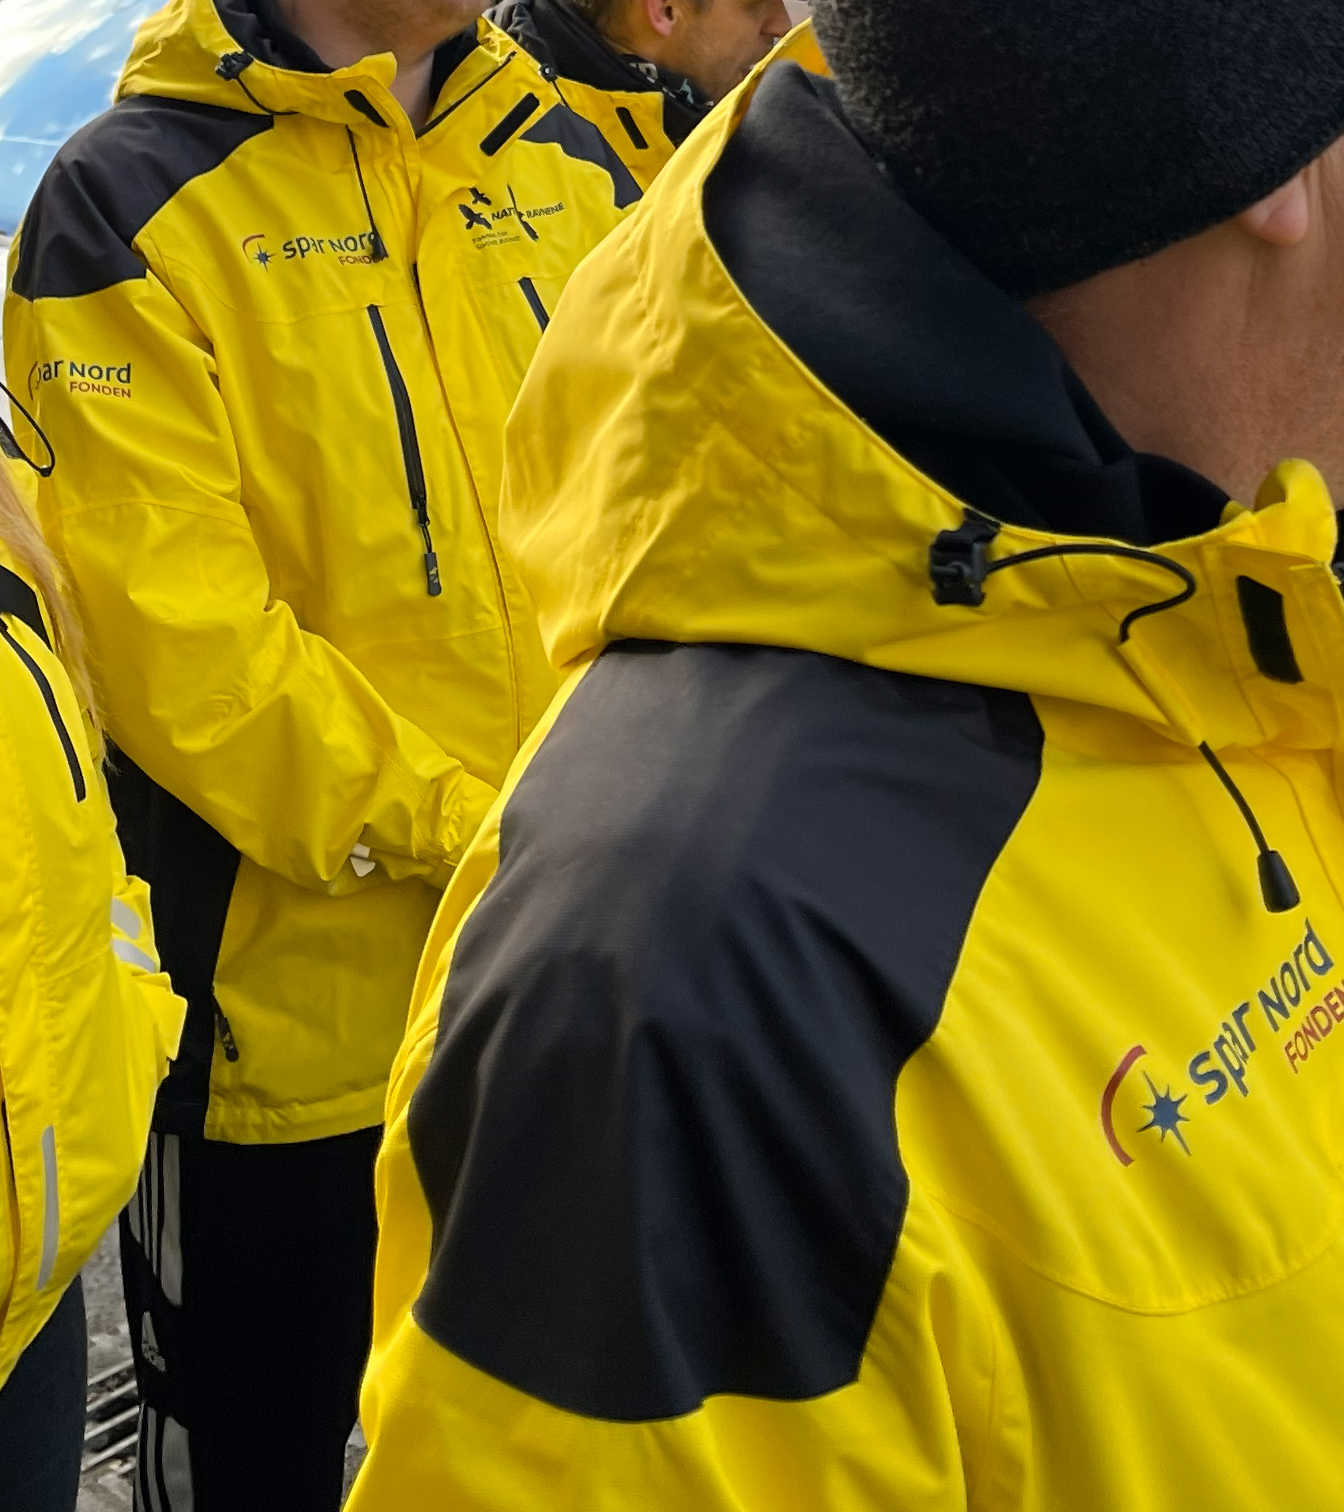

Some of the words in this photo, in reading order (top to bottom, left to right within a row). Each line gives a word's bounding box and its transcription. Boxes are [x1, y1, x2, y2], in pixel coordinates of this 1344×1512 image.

[69, 361, 132, 384] Nord
[69, 380, 132, 399] FONDEN
[1257, 916, 1334, 1033] Nord
